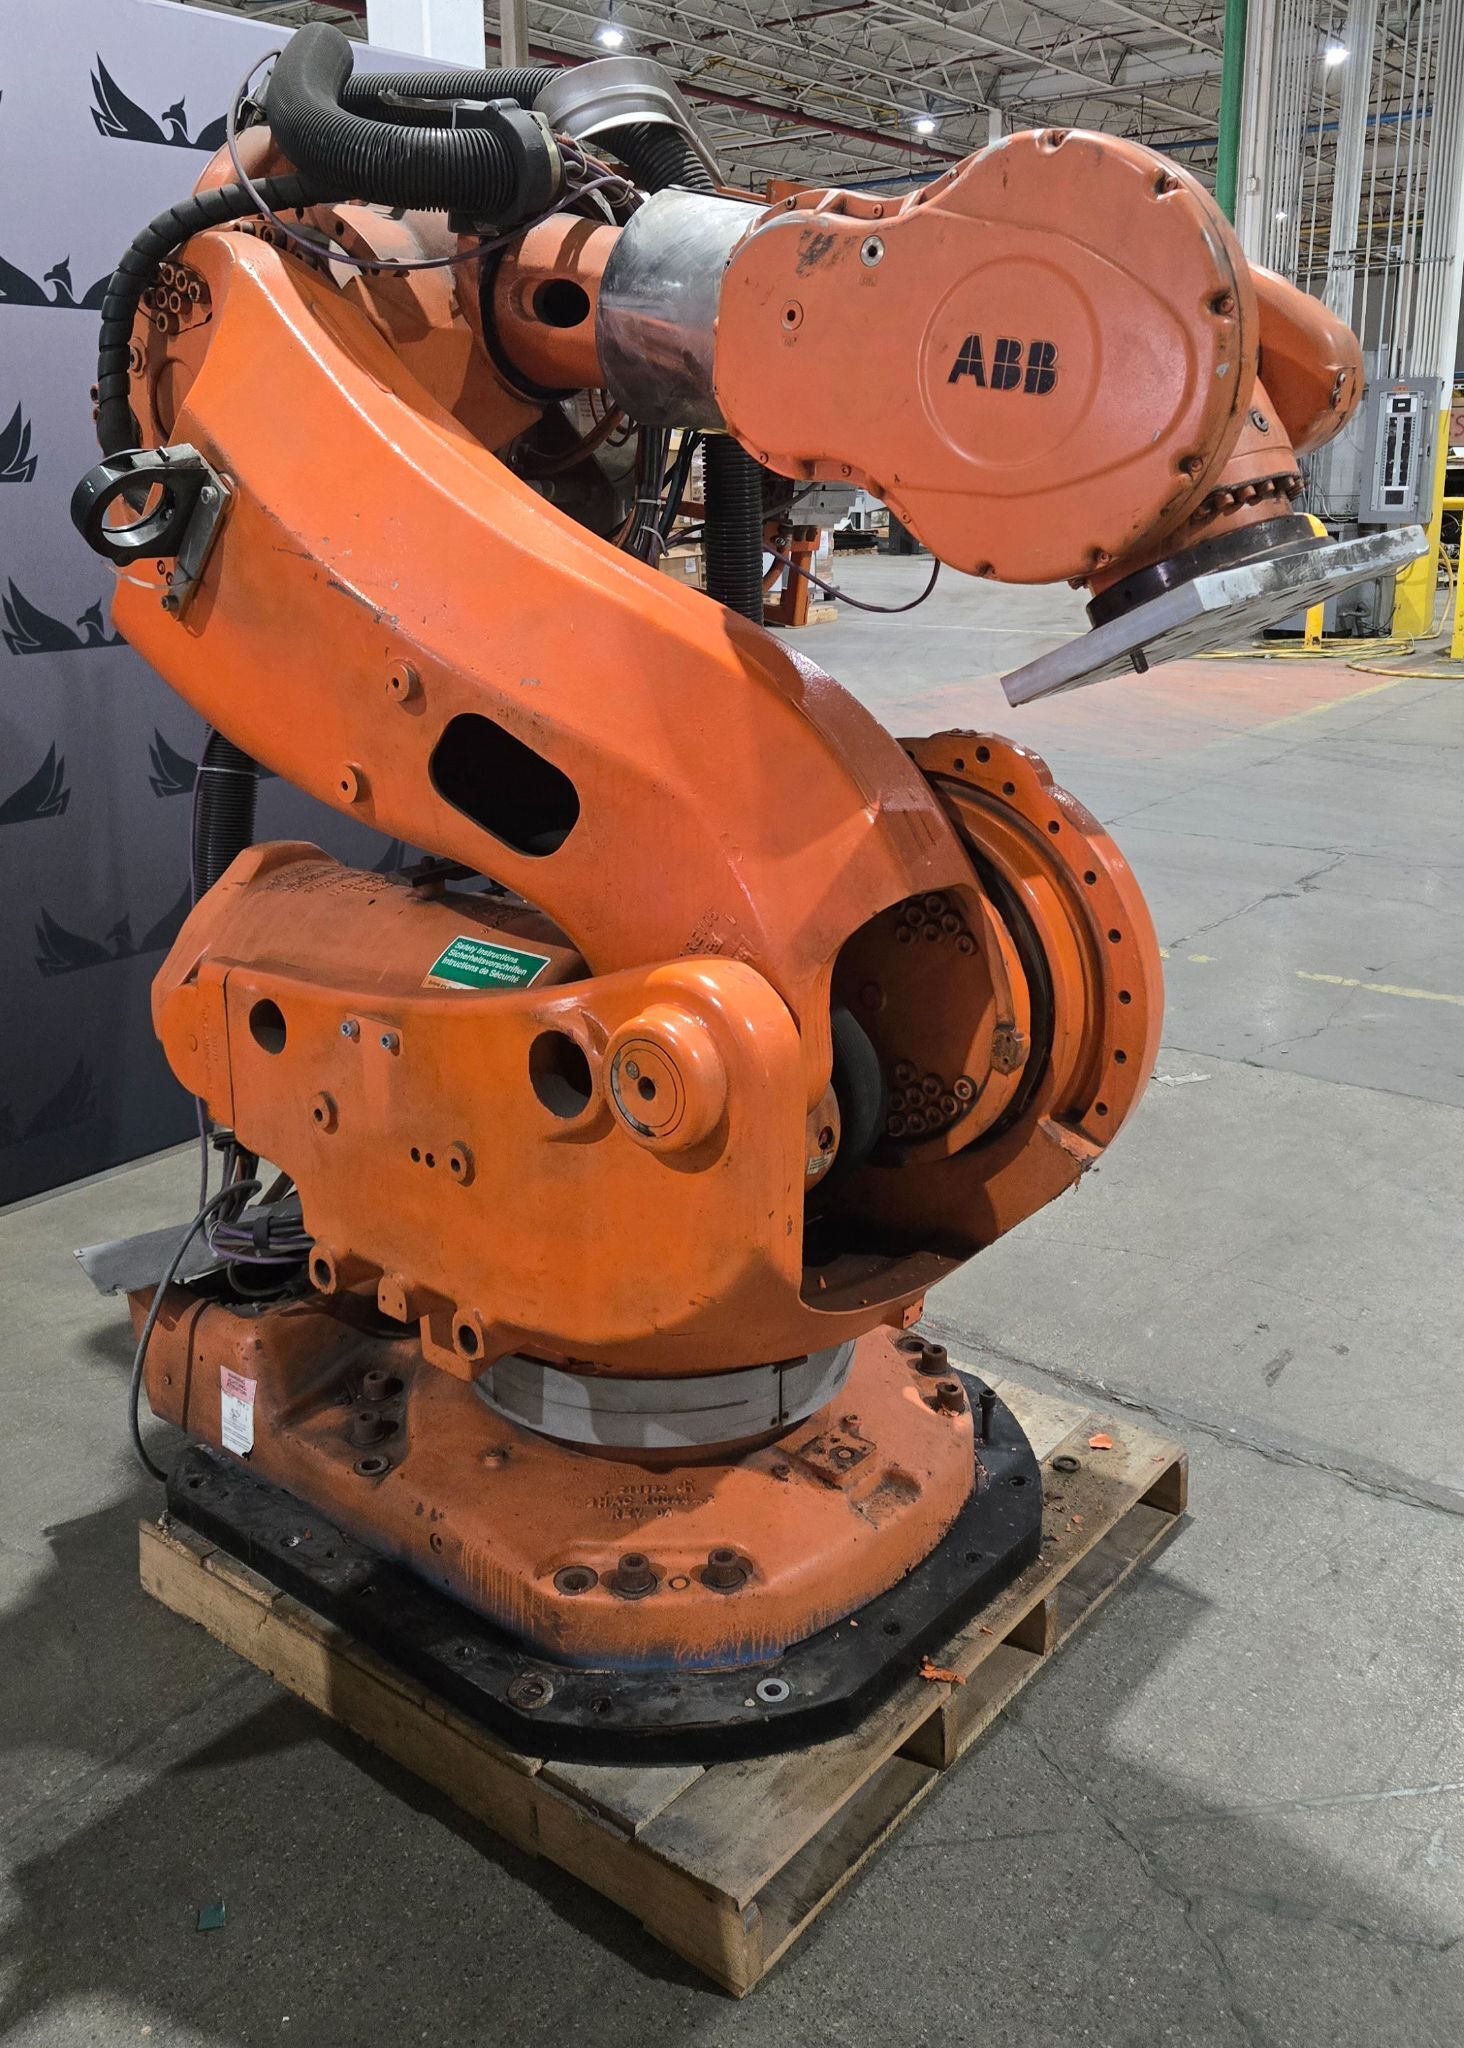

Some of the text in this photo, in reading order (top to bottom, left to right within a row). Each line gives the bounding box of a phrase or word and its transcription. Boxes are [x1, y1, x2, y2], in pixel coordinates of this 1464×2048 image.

[946, 333, 1059, 395] ABB
[447, 949, 528, 976] Sicherheitsvorschriften
[454, 941, 519, 964] Safety Instructions
[479, 967, 490, 975] de
[489, 968, 520, 984] Sécurité
